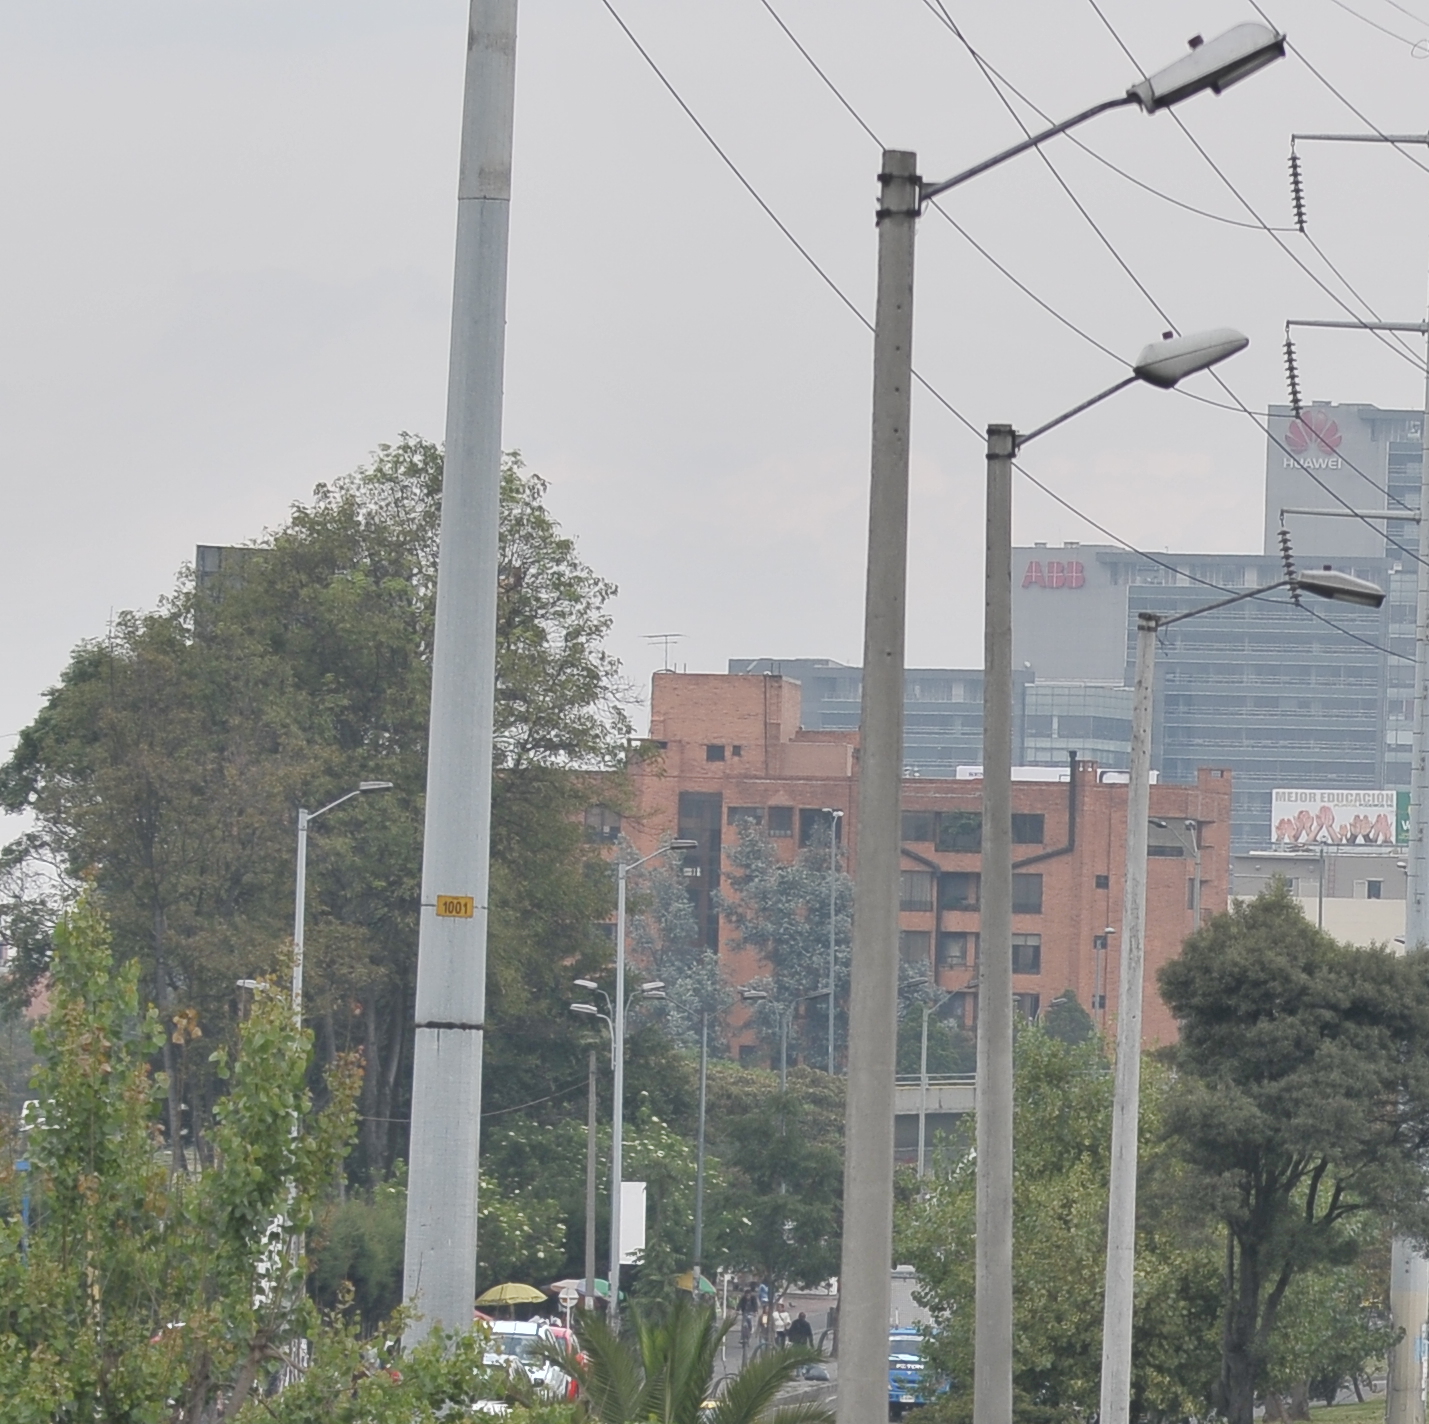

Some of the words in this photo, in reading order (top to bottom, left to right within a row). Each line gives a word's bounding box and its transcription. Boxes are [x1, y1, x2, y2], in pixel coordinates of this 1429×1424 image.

[1283, 458, 1342, 469] HUAWEI
[1022, 561, 1085, 589] ABB
[1275, 791, 1317, 803] MEJOR
[443, 901, 468, 915] 1001
